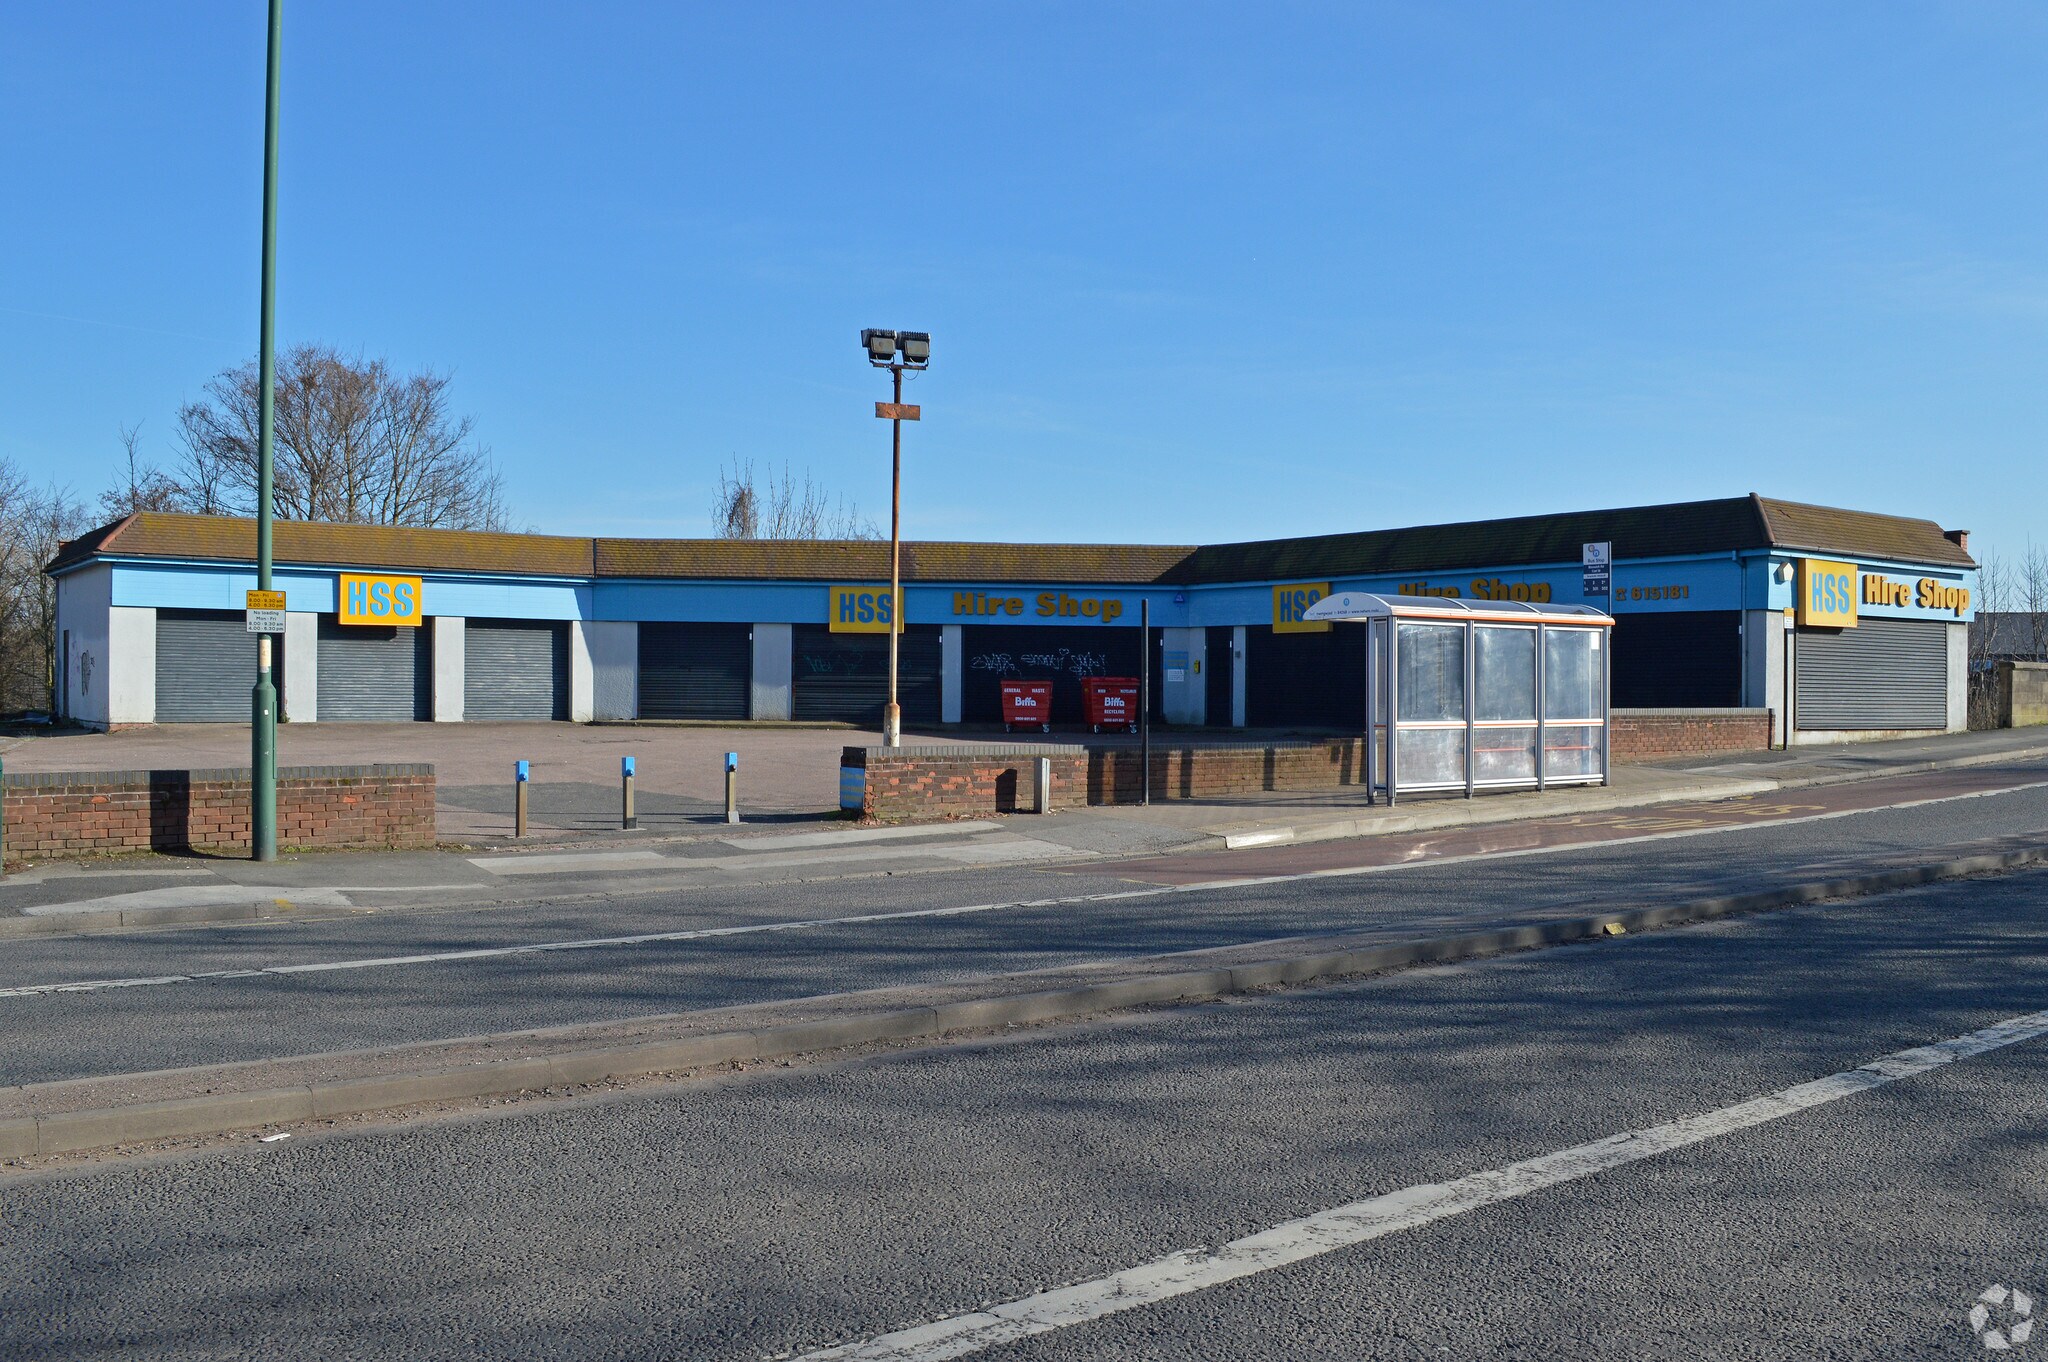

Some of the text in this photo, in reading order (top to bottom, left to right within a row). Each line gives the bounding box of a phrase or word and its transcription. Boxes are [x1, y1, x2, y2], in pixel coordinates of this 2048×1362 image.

[348, 582, 414, 616] HSS
[1470, 578, 1551, 603] Shop
[1631, 585, 1689, 600] 615181
[1812, 572, 1850, 614] HSS
[1864, 574, 1970, 616] Hire Shop
[839, 593, 892, 623] HSS
[954, 592, 1122, 622] Hire Shop
[1015, 696, 1036, 706] Biffa
[1105, 697, 1125, 706] Biffa
